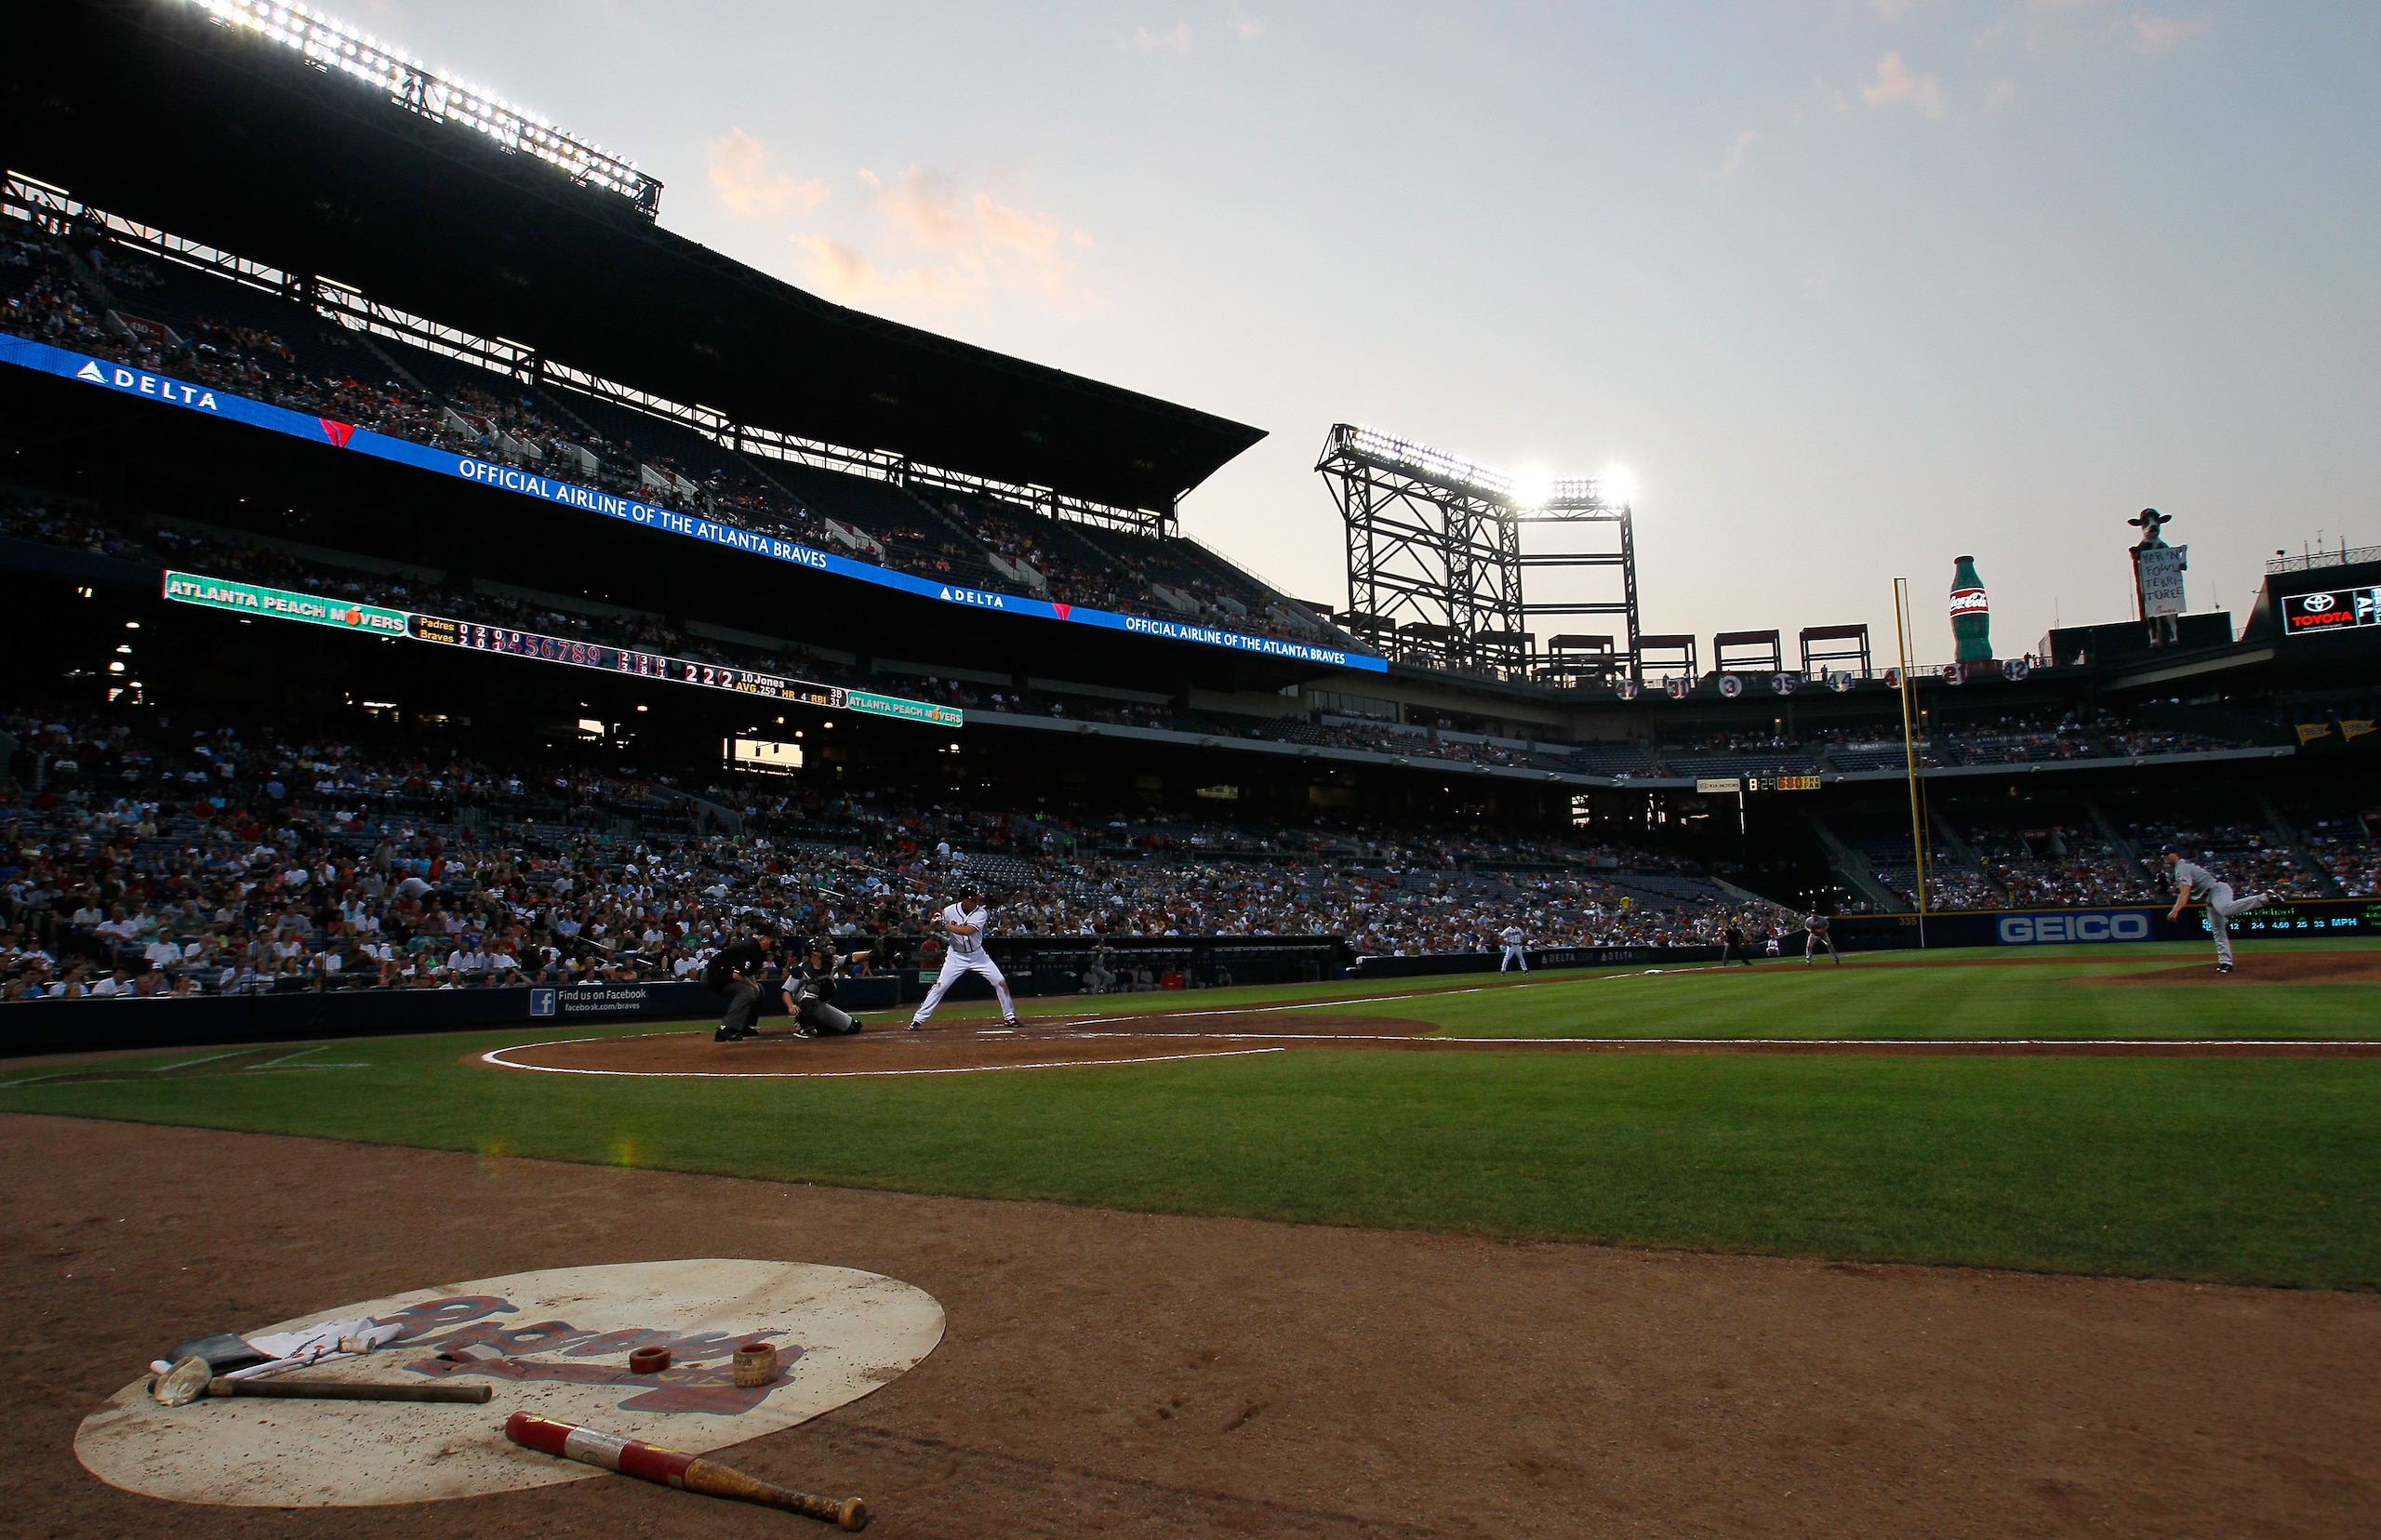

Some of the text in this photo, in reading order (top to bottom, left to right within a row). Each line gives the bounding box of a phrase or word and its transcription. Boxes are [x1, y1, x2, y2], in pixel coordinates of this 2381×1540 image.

[113, 368, 217, 410] DELTA
[459, 459, 827, 568] OFFICIAL AIRLINE OF THE ATLANTA BRAVES
[2142, 551, 2164, 564] YER
[2146, 564, 2179, 577] FOWL
[168, 580, 258, 607] ATLANTA
[263, 595, 326, 617] PEACH
[954, 589, 1004, 609] DELTA
[1949, 591, 1987, 612] Coca-Cola
[2291, 610, 2354, 627] TOYOTA
[420, 617, 520, 644] Padres 0 2 0 0
[420, 630, 454, 644] Braves
[459, 635, 469, 645] 2
[477, 638, 486, 648] 0
[525, 636, 539, 657] 5
[541, 639, 554, 658] 6
[557, 642, 570, 661] 7
[571, 644, 586, 664] 8
[587, 646, 601, 666] 9
[1125, 617, 1346, 665] OFFICIAL AIRLINE OF THE ATLANTA BRAVES
[641, 656, 648, 665] 3
[641, 666, 648, 675] 8
[686, 665, 734, 688] 2 2 2
[1943, 666, 1966, 683] 21
[2003, 661, 2029, 679] 42
[741, 672, 753, 684] 10
[753, 674, 785, 689] Jones
[1669, 681, 1688, 697] 31
[1723, 680, 1736, 695] 3
[1771, 677, 1796, 692] 35
[1825, 675, 1856, 690] 44
[736, 682, 757, 693] AVG
[781, 689, 795, 699] HR
[800, 693, 807, 701] 4
[810, 694, 827, 704] RBI
[830, 697, 841, 707] 31
[849, 696, 891, 712] ATLANTA
[893, 703, 924, 717] PEACH
[1778, 777, 1802, 790] 680
[1899, 916, 1918, 926] 335
[2001, 913, 2148, 943] GEICO
[2313, 920, 2325, 928] 33
[2331, 917, 2358, 927] MPH
[558, 988, 646, 1001] Find us on Facebook
[565, 1002, 640, 1012] facebook.com/braves
